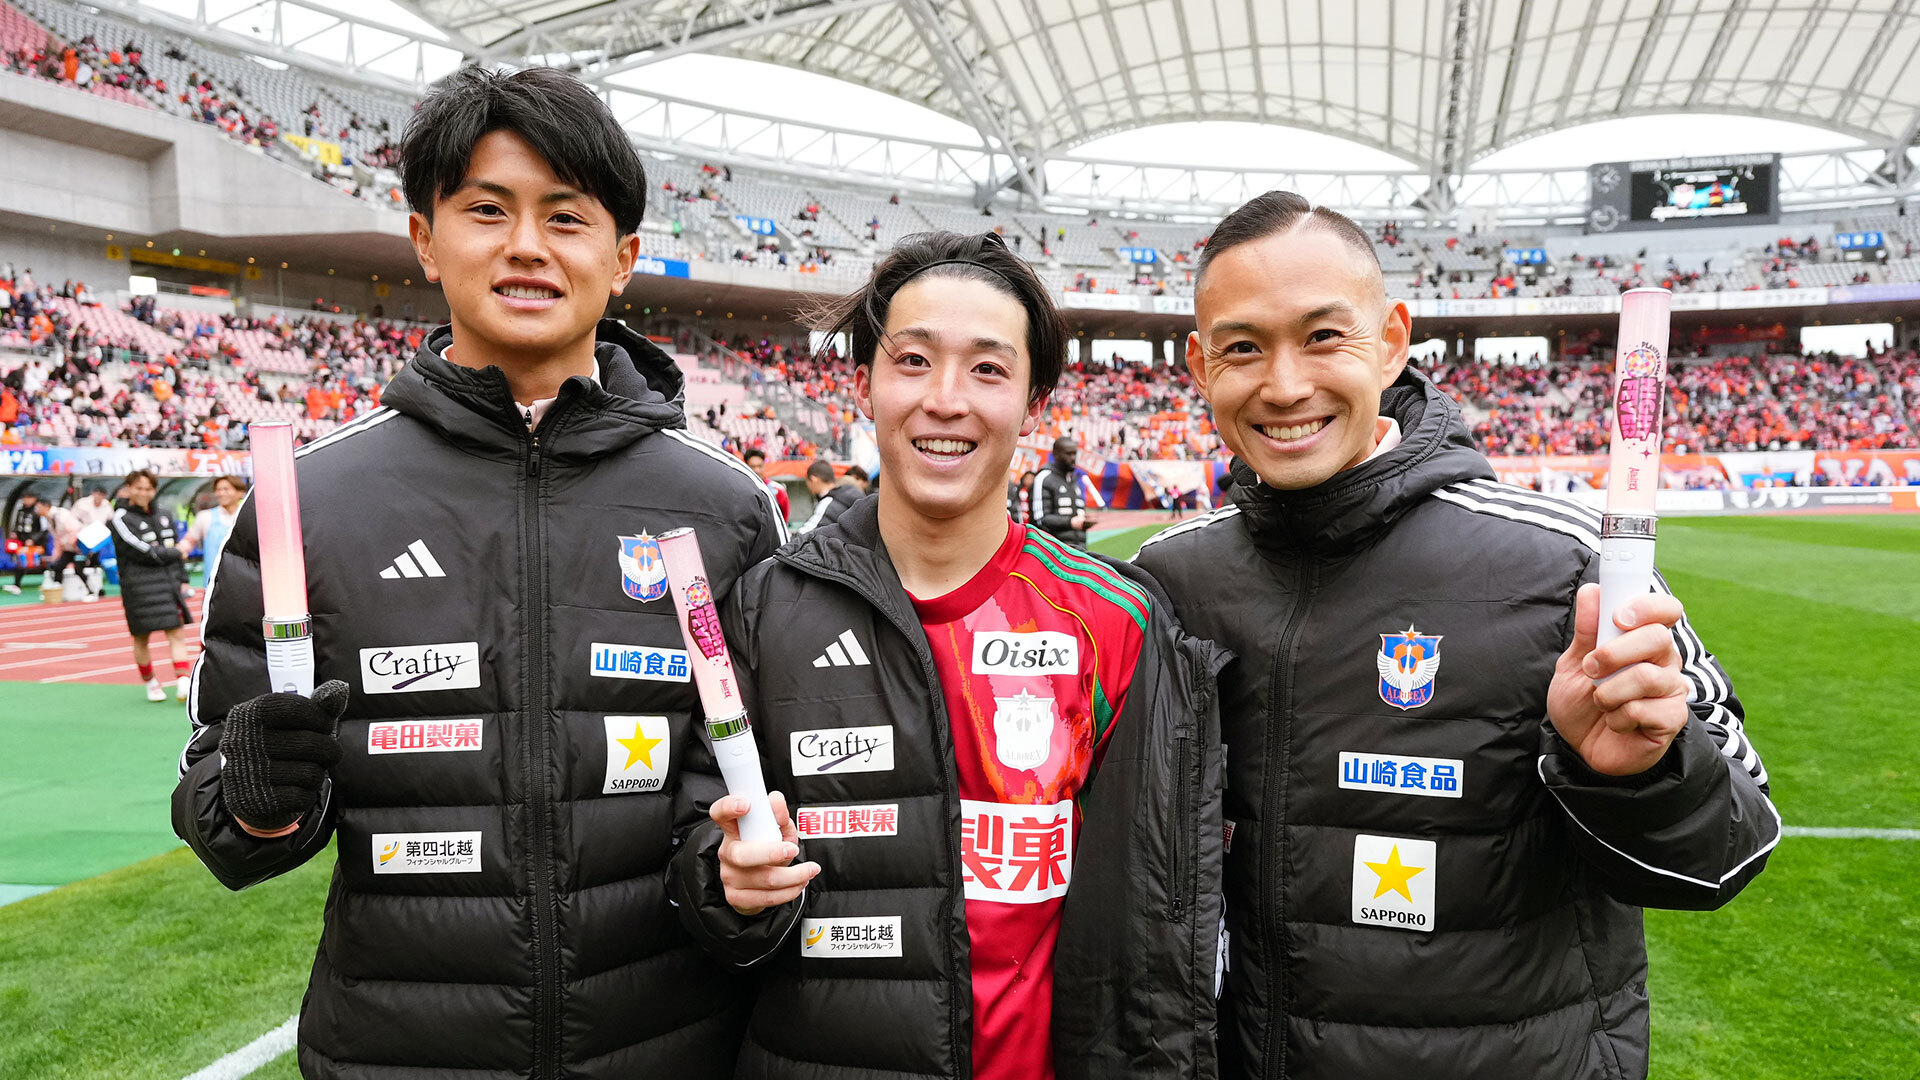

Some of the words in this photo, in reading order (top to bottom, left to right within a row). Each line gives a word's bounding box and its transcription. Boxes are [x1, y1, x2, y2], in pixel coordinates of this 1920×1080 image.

[1620, 379, 1639, 440] FEVER
[1640, 377, 1657, 441] NIGHT
[690, 608, 715, 659] FEVER
[369, 648, 463, 682] Crafty
[595, 649, 687, 677] 山崎食品
[981, 639, 1070, 668] Oisix
[371, 723, 480, 750] 亀田製菓
[797, 731, 879, 763] Crafty
[610, 777, 660, 790] SAPPORO
[1344, 757, 1457, 792] 山崎食品
[798, 808, 896, 835] 亀田製菓
[406, 839, 474, 857] 第四北越
[406, 857, 474, 866] フィナンシャルグループ
[961, 813, 1068, 891] 製菓
[1360, 907, 1426, 926] SAPPORO
[830, 923, 894, 942] 第四北越
[830, 942, 894, 951] フィナンシャルグループ
